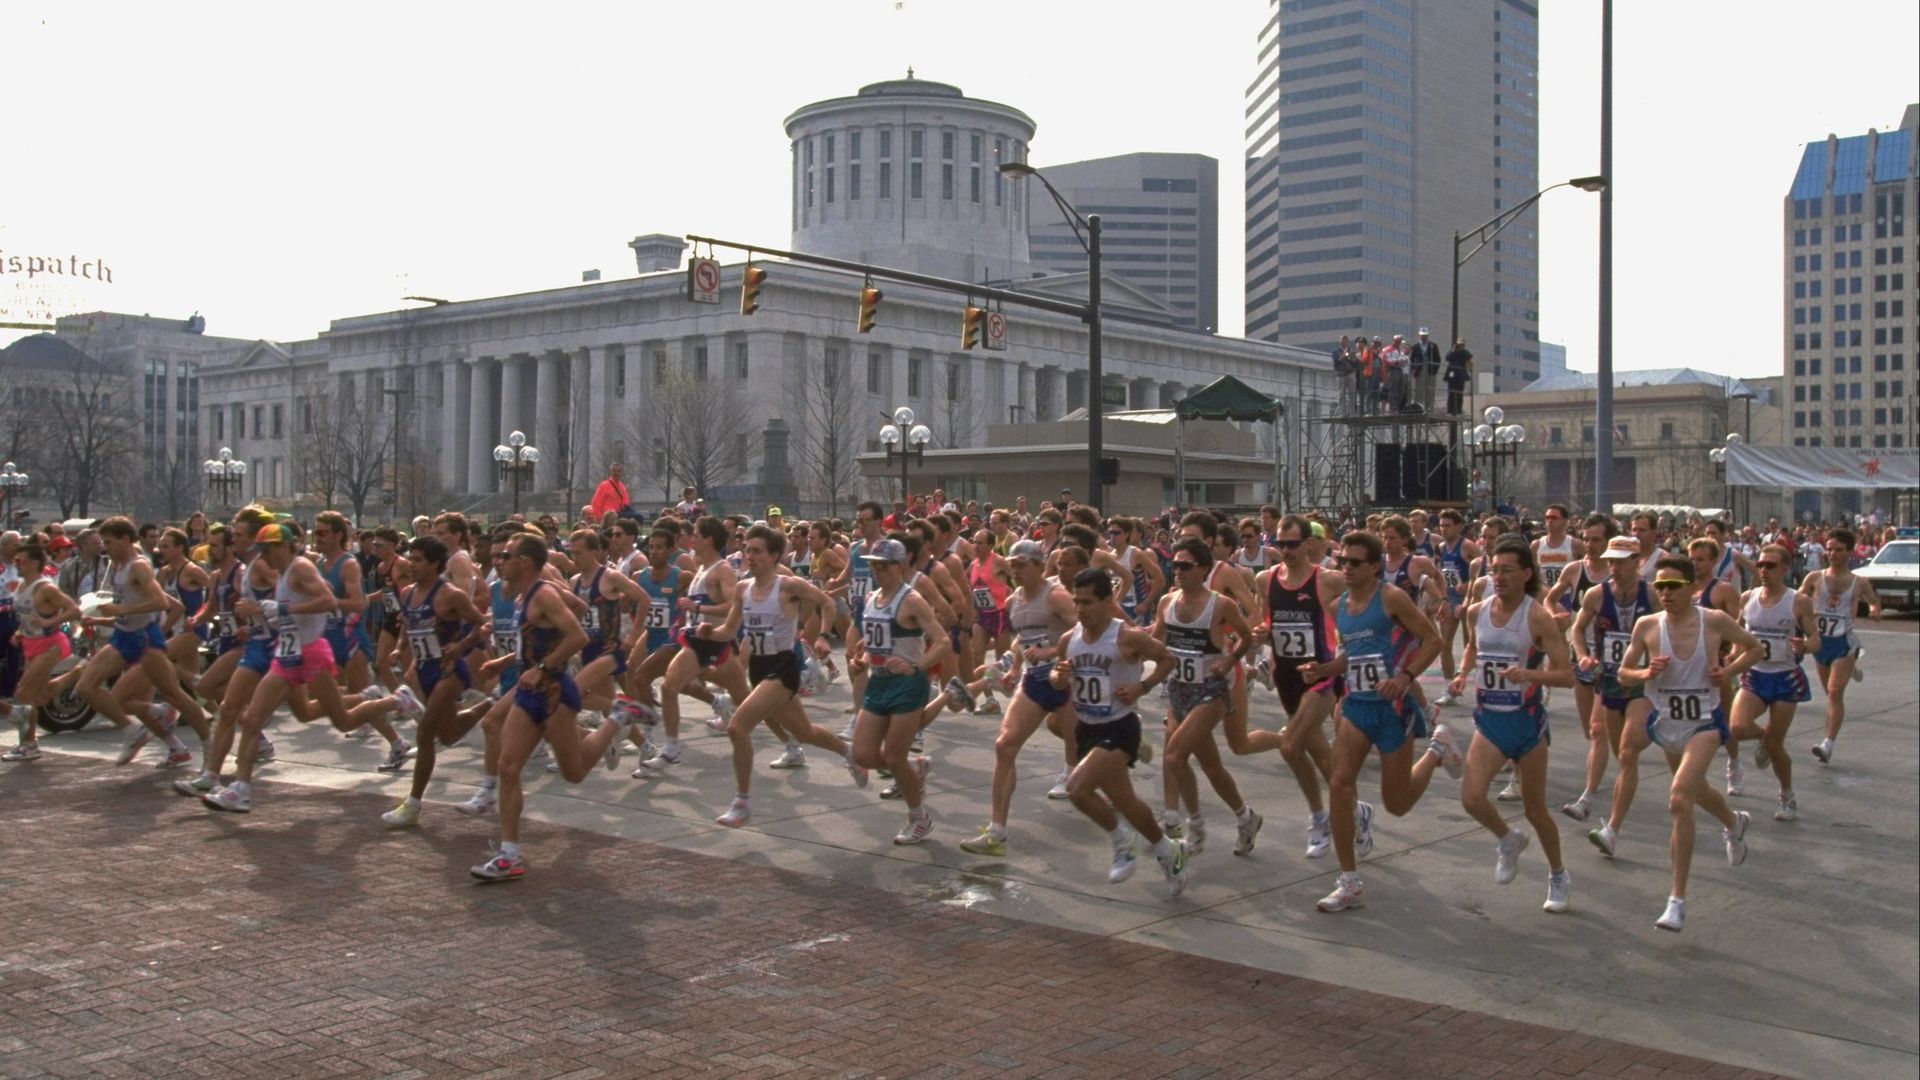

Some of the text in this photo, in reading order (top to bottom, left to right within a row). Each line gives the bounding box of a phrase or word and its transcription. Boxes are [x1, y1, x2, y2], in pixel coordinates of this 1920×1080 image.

[866, 622, 884, 647] 50
[1818, 617, 1838, 636] 97
[1280, 631, 1307, 657] 23
[1074, 676, 1101, 704] 20
[1351, 663, 1378, 691] 79
[1669, 694, 1701, 721] 80
